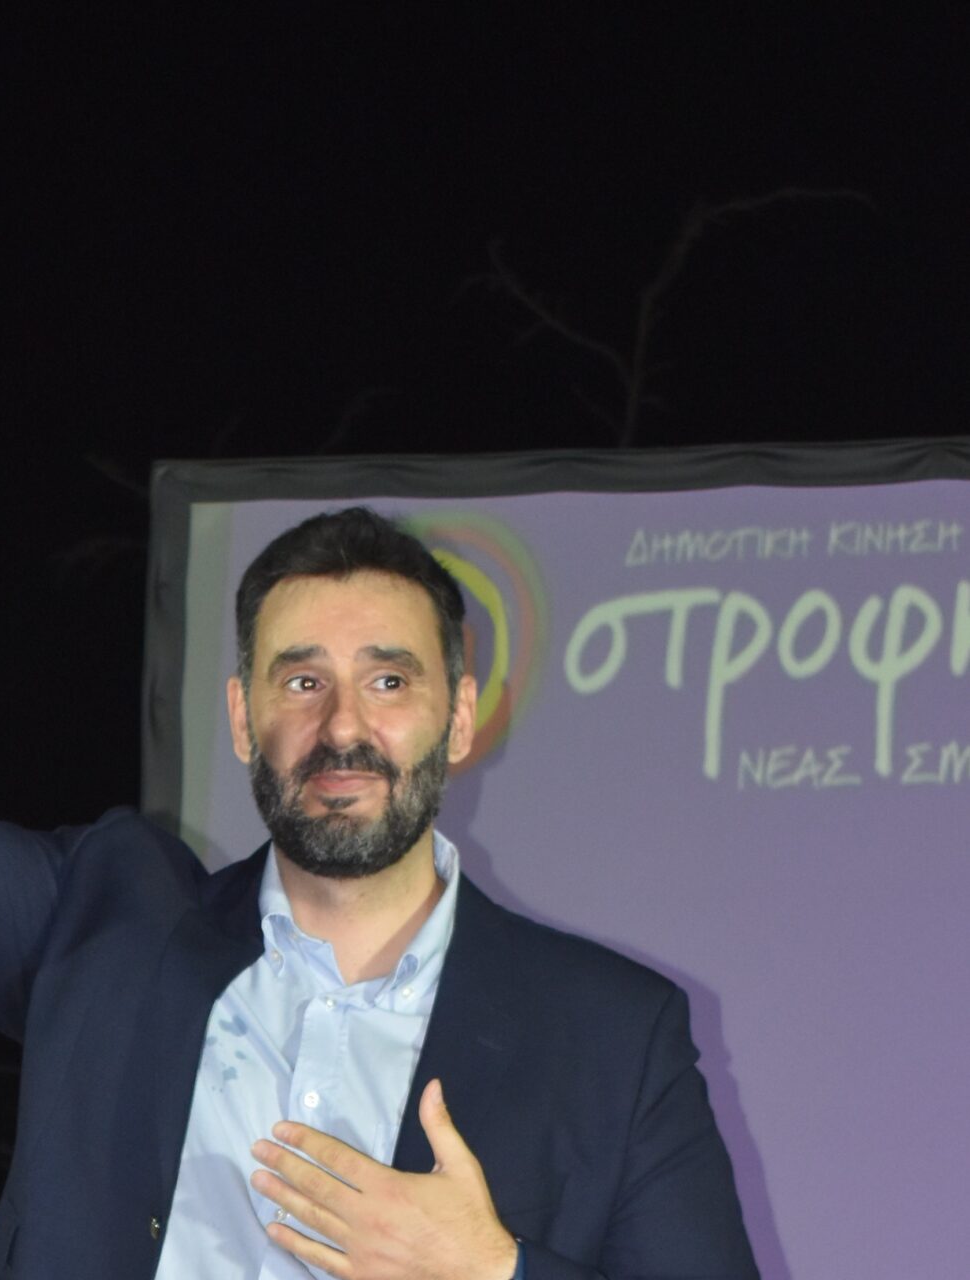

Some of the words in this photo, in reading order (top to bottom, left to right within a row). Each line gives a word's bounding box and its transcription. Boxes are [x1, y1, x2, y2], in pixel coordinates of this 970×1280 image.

[626, 527, 813, 566] ΔΗΜΟΤΙΚΗ
[828, 519, 962, 554] ΚΙΝΗΣΗ
[738, 744, 862, 789] ΝΕΑΣ
